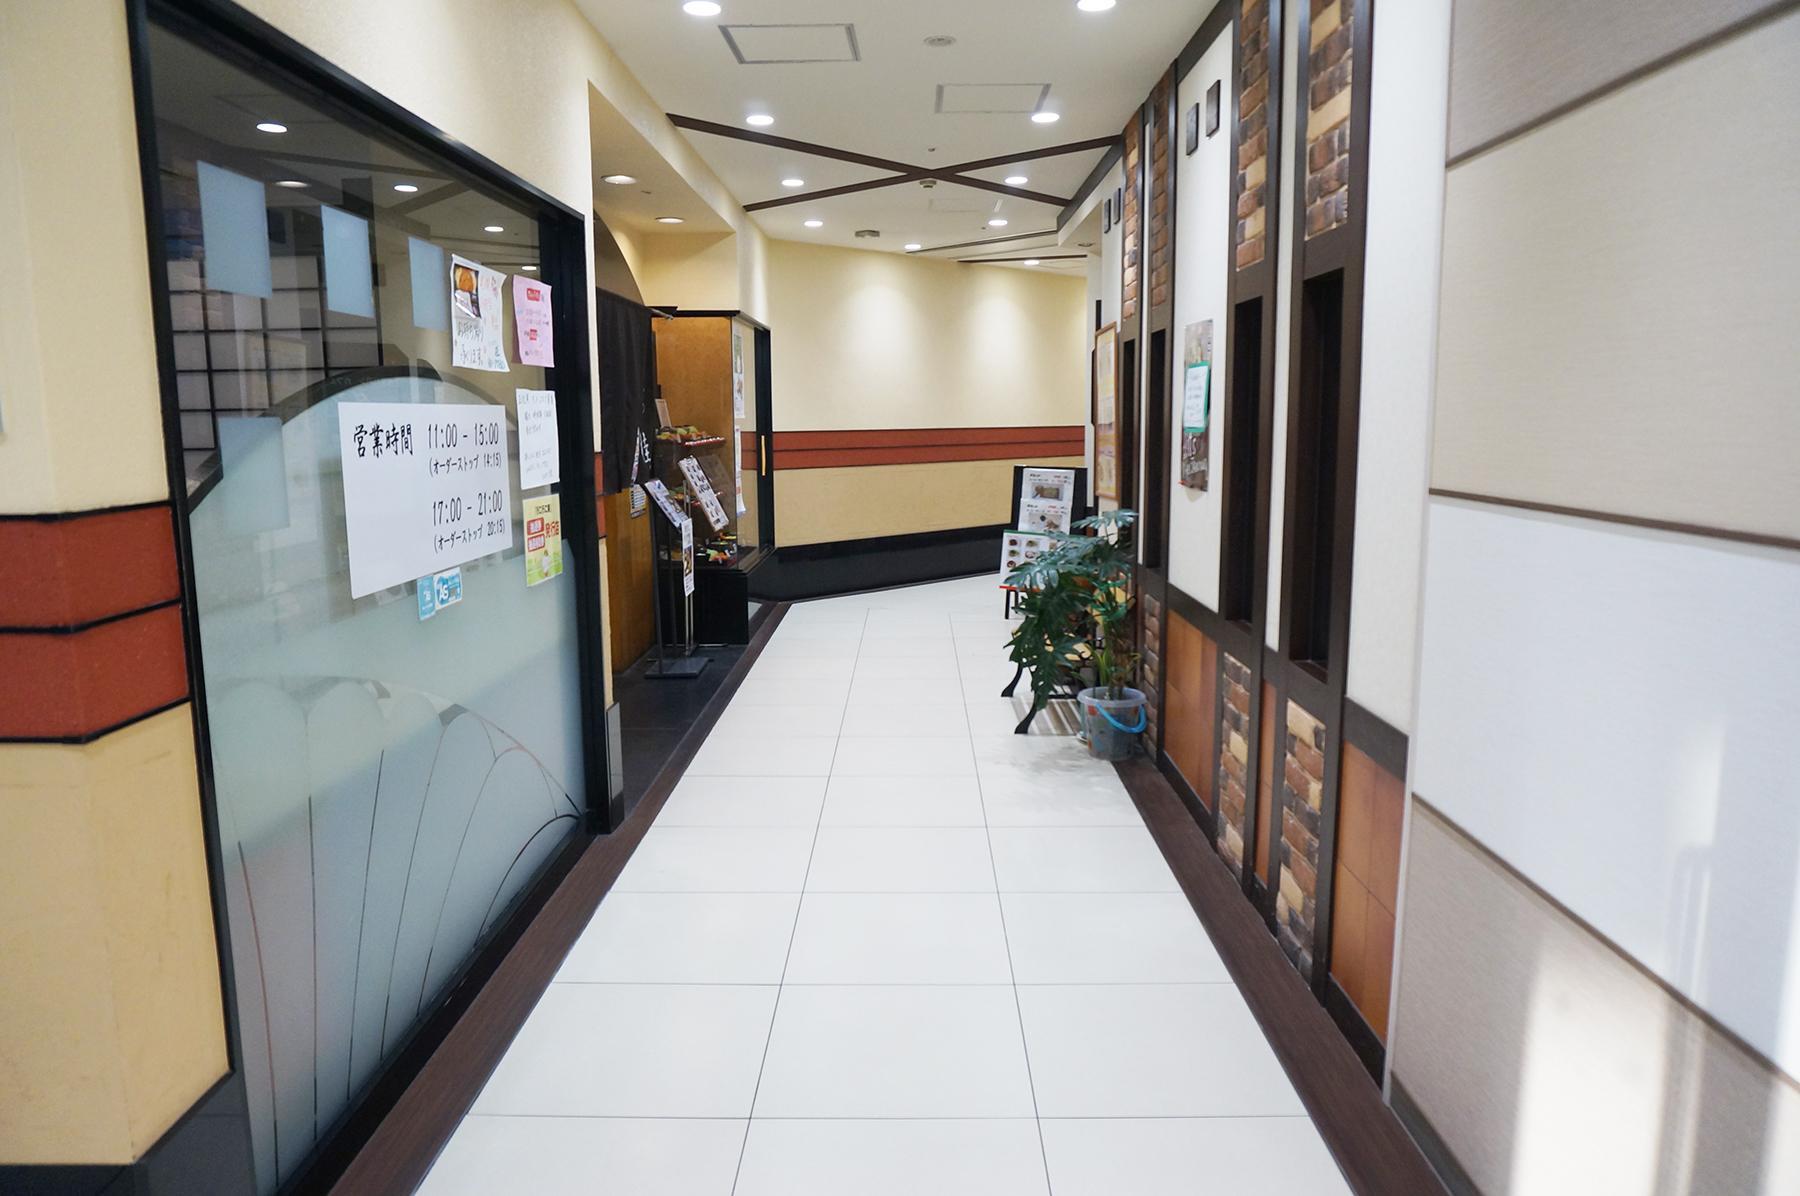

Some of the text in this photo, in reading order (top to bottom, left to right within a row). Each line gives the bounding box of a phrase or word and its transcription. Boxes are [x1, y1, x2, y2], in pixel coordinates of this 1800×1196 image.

[354, 422, 413, 458] 営業時間
[428, 423, 458, 449] 11:00
[475, 422, 499, 446] 15:00
[429, 454, 479, 477] (オーダーストップ
[433, 496, 462, 527] 17:00
[478, 489, 503, 515] 21:00
[434, 523, 483, 554] (オーダーストップ
